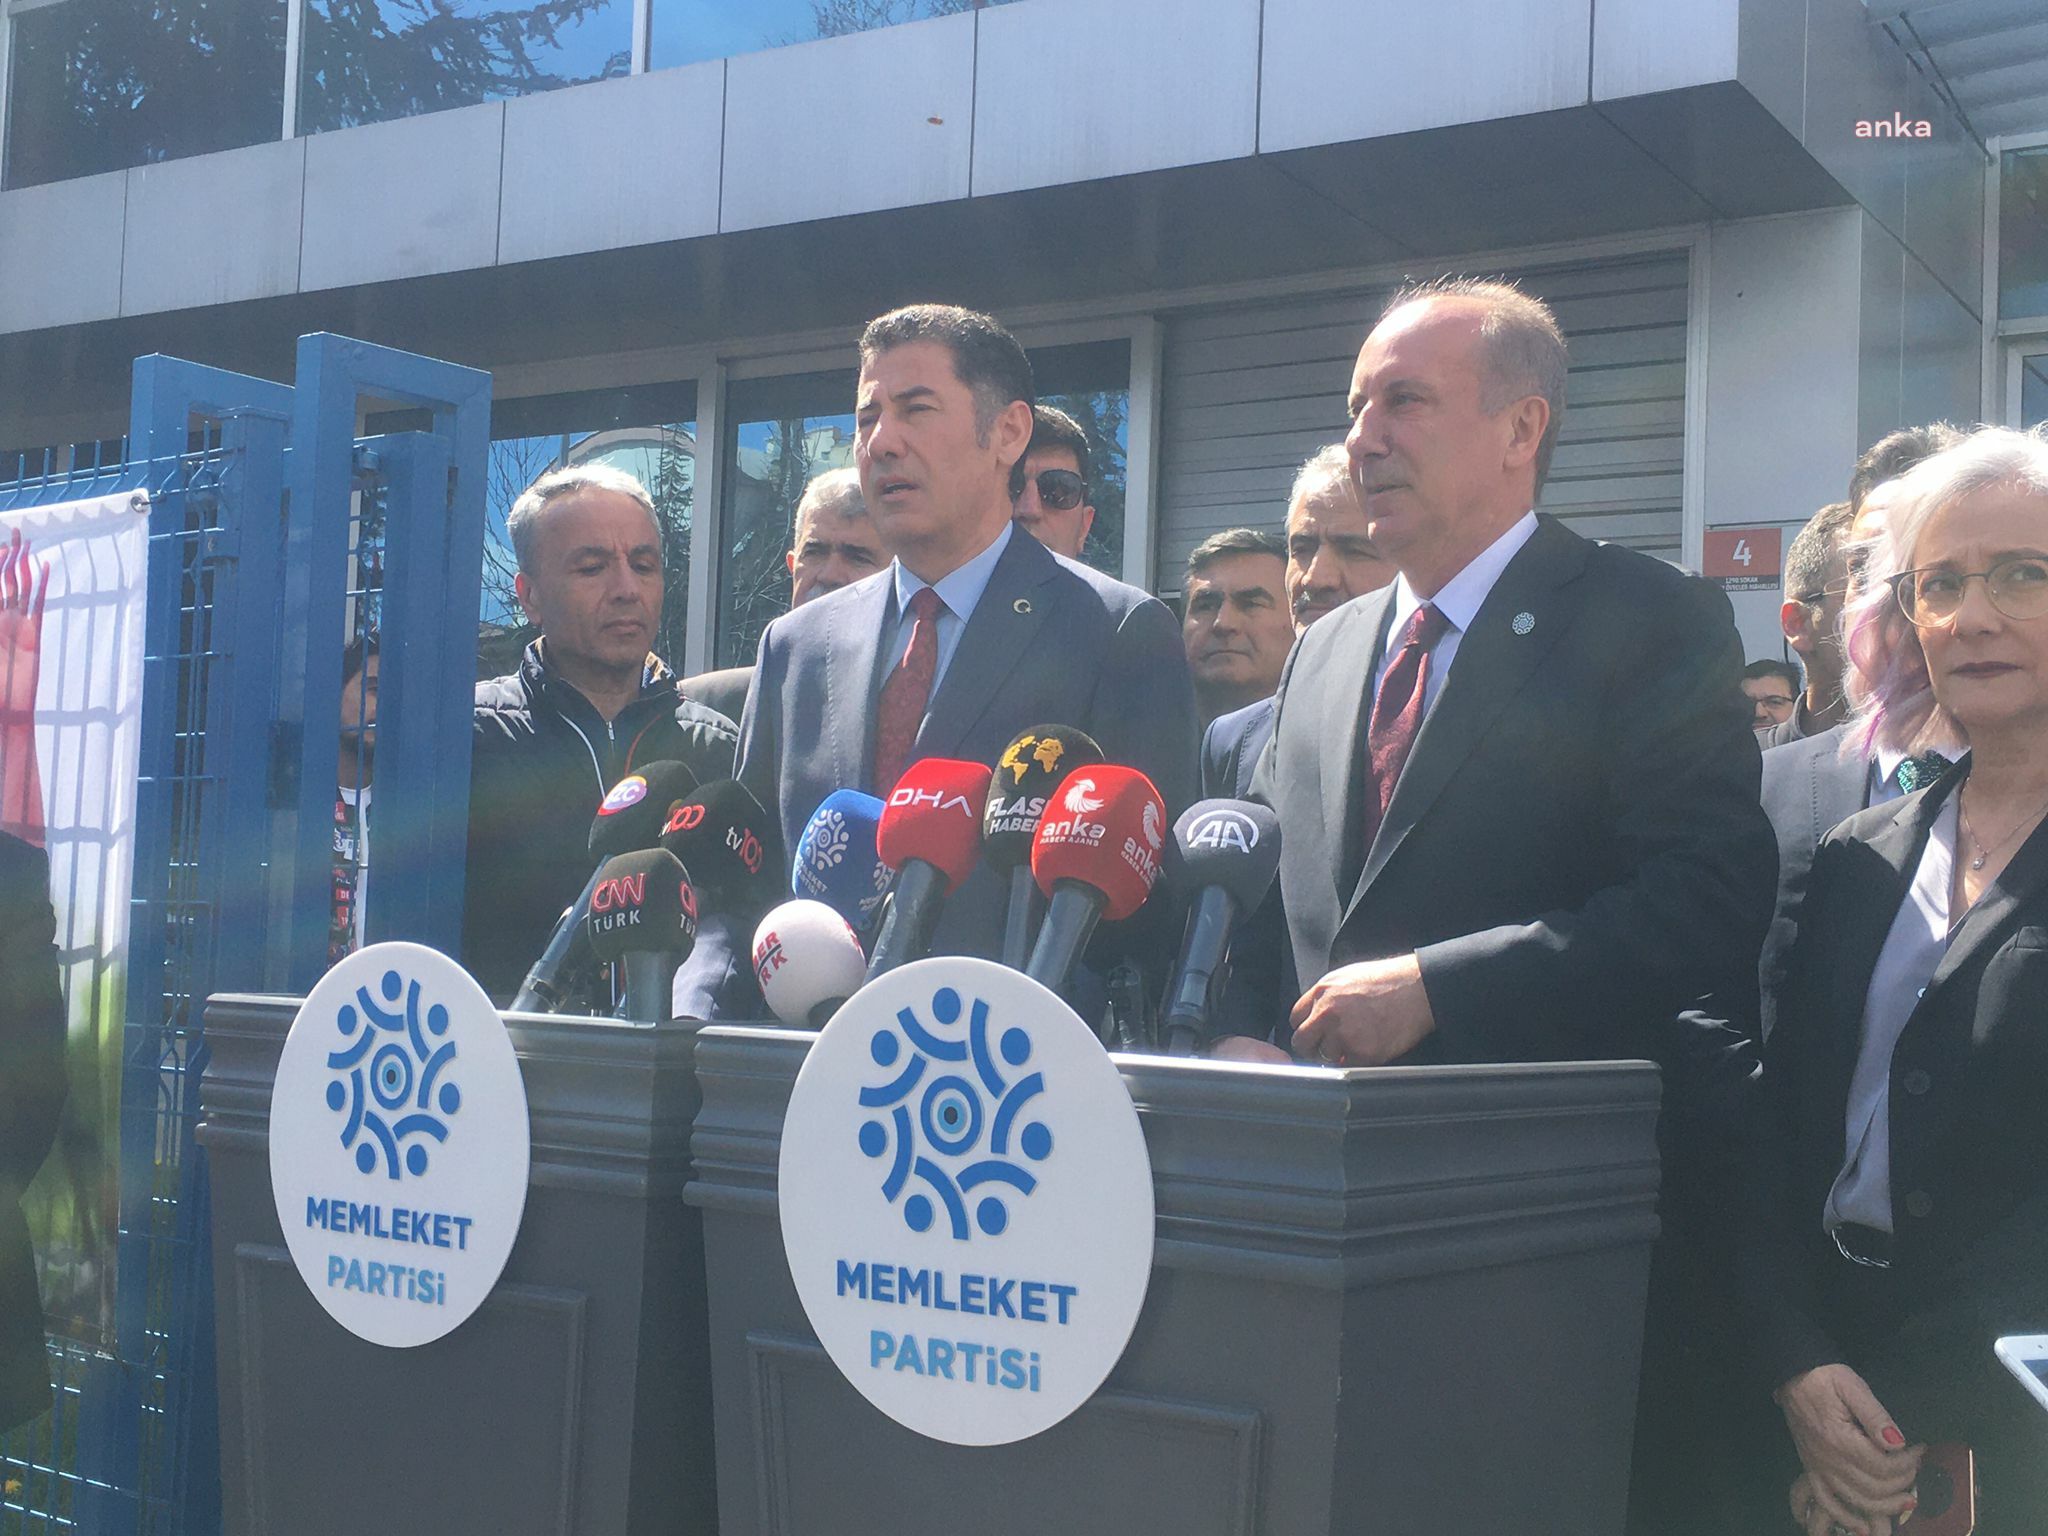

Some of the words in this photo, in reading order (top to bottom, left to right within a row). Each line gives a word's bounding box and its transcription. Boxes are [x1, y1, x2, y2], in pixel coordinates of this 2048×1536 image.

[1732, 539, 1752, 567] 4
[889, 787, 973, 818] DHA
[984, 796, 1046, 821] FLAS
[1042, 814, 1106, 839] anka
[1188, 820, 1250, 854] AA
[592, 873, 646, 913] CNN
[593, 909, 641, 934] TÜRK
[306, 1196, 472, 1250] MEMLEKET
[836, 1259, 1077, 1325] MEMLEKET
